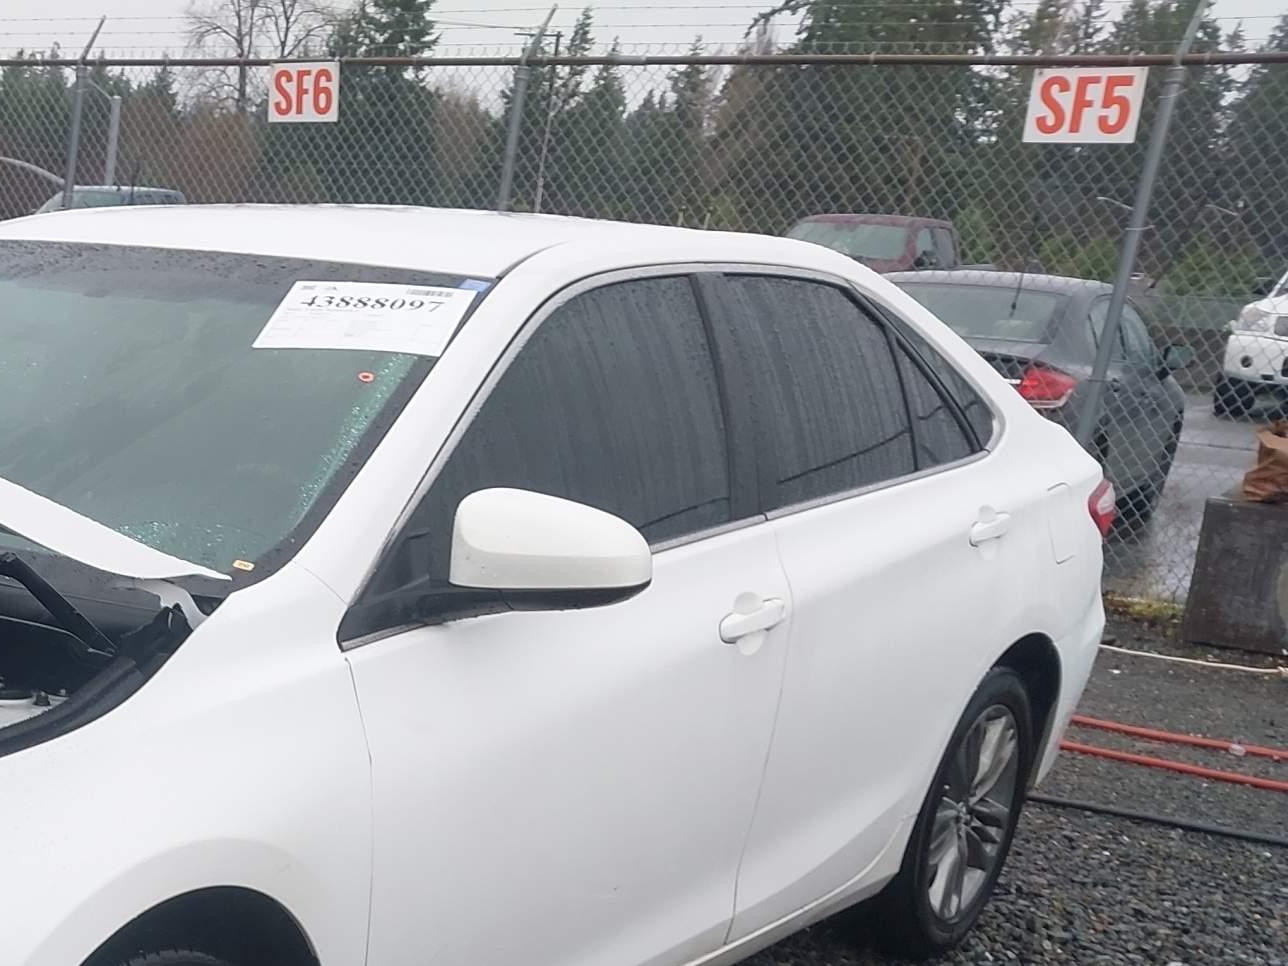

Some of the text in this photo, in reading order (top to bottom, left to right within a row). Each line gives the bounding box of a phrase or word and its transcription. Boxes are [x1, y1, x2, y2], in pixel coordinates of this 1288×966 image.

[274, 68, 333, 116] SF6
[1036, 75, 1135, 134] SF5
[300, 294, 446, 313] 43888097
